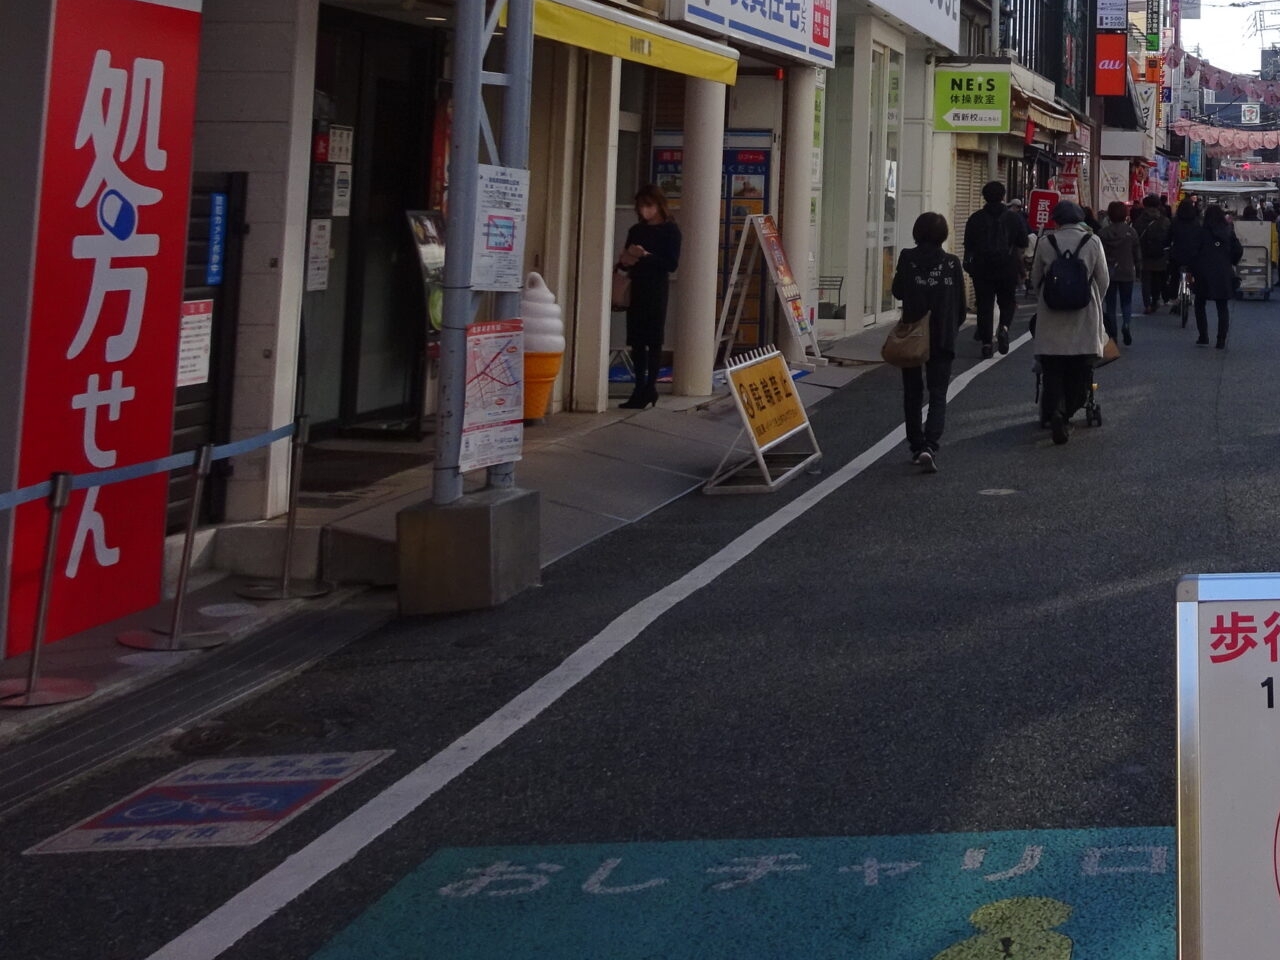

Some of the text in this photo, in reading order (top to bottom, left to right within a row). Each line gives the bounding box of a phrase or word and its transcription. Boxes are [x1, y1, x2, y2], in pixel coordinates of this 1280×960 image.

[1098, 59, 1124, 70] au
[66, 49, 167, 578] 処方せん
